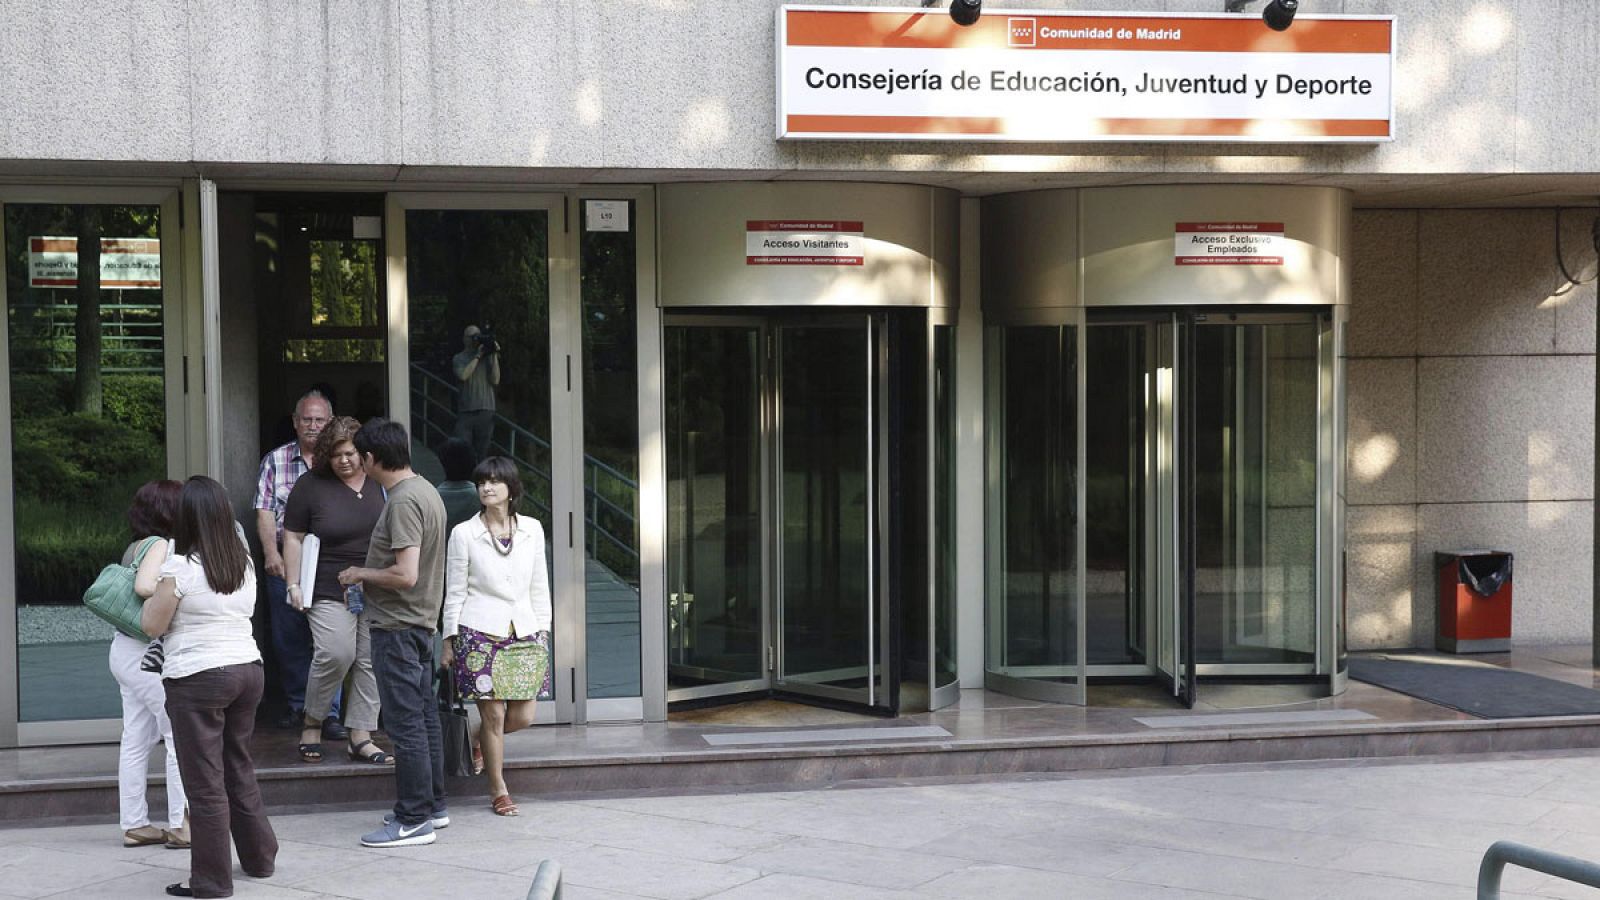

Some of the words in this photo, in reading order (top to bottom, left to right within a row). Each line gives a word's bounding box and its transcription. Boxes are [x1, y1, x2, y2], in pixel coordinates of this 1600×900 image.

[1039, 27, 1113, 39] Comunidad
[1116, 28, 1132, 39] de
[1136, 28, 1181, 40] Madrid
[805, 67, 942, 94] Consejería
[950, 70, 981, 91] de
[990, 70, 1127, 96] Educación,
[1135, 72, 1247, 94] Juventud
[1255, 77, 1268, 99] y
[1275, 74, 1372, 99] Deporte
[763, 239, 800, 249] Acceso
[802, 239, 849, 249] Visitantes
[1191, 235, 1226, 244] Acceso
[1229, 235, 1272, 244] Exclusivo
[1207, 245, 1258, 255] Empleados
